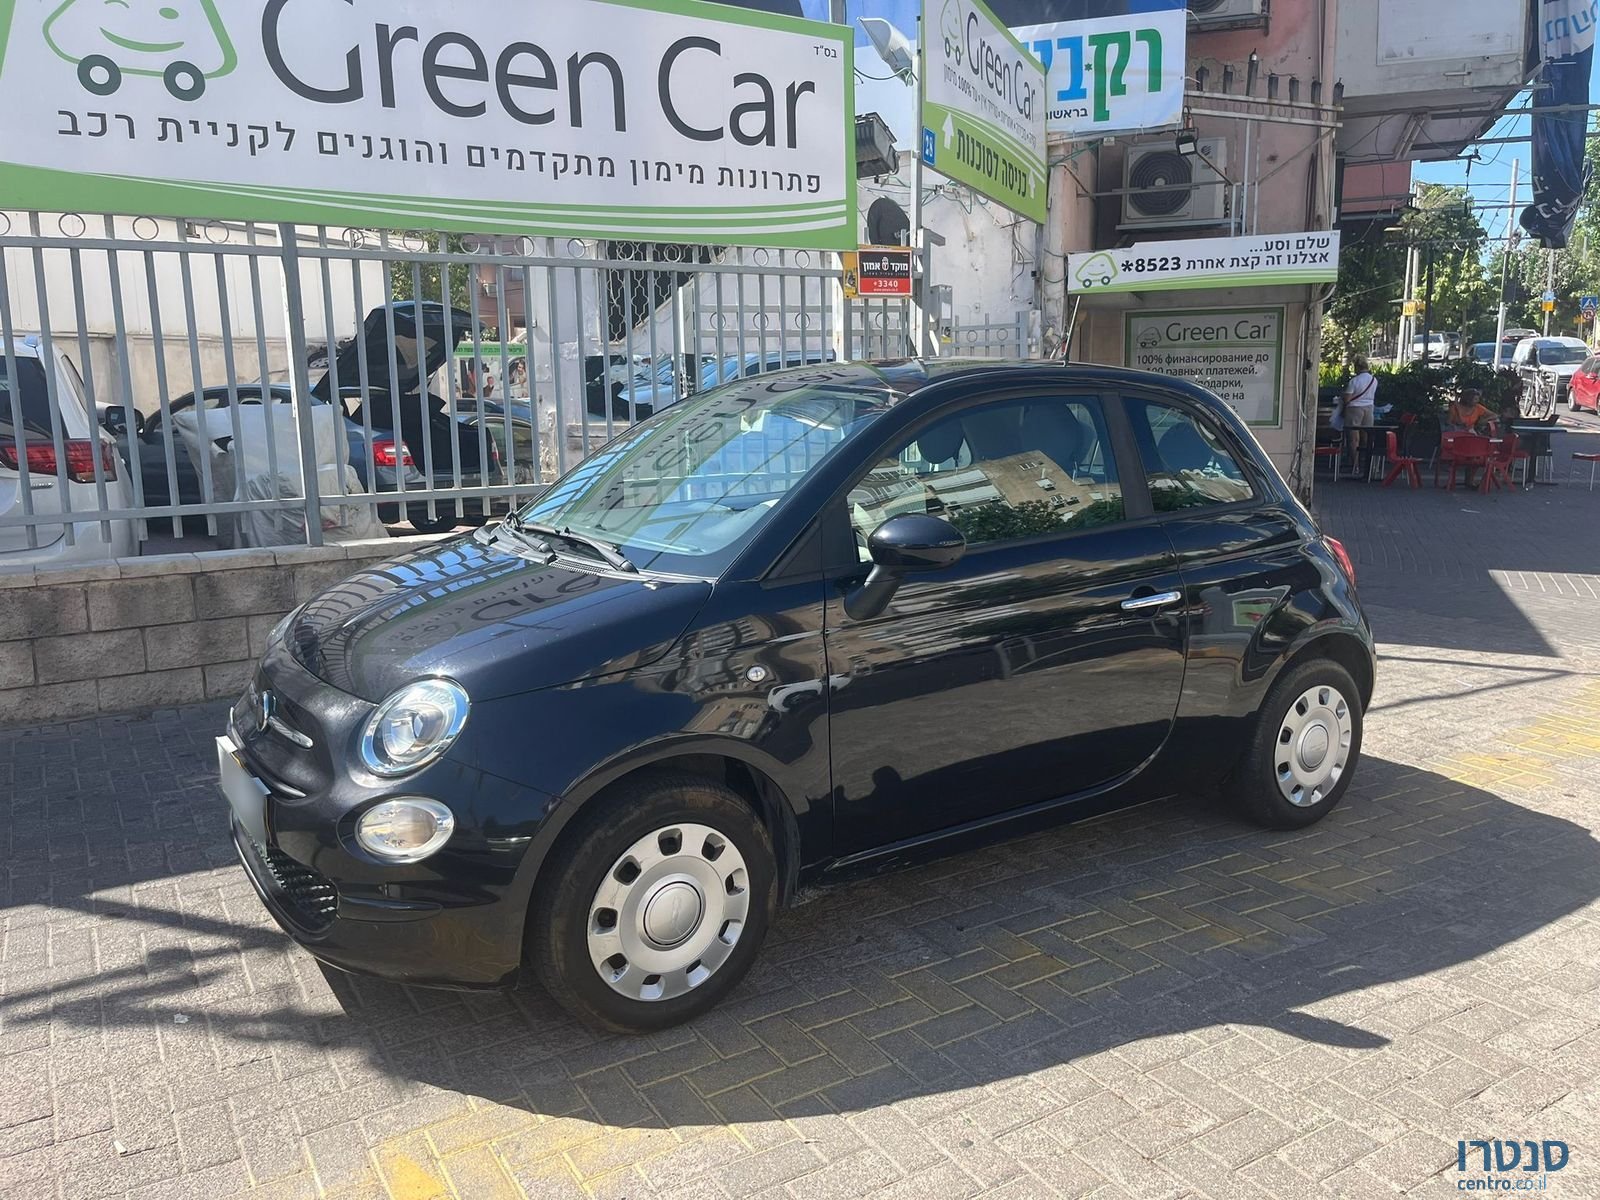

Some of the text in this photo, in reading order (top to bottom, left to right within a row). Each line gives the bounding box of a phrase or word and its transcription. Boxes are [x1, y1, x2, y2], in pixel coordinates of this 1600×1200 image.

[813, 45, 837, 59] בס"ד
[261, 0, 816, 149] Green Car
[967, 12, 1036, 123] Green Car
[57, 110, 821, 194] פתרונות מימון מתקדמים והוגנים לקניית רכב
[957, 128, 999, 181] לסוכנות
[1002, 158, 1027, 198] כניסה
[1249, 236, 1330, 253] שלם וסע...
[1186, 257, 1225, 270] אחרת
[1229, 255, 1260, 270] קצת
[1265, 254, 1282, 266] זה
[1287, 251, 1329, 265] אצלנו
[890, 262, 908, 272] מוקד
[1166, 320, 1271, 342] Green Car
[1137, 353, 1269, 366] 100% финансирование до
[1205, 364, 1258, 375] платежей.
[1232, 392, 1245, 400] на
